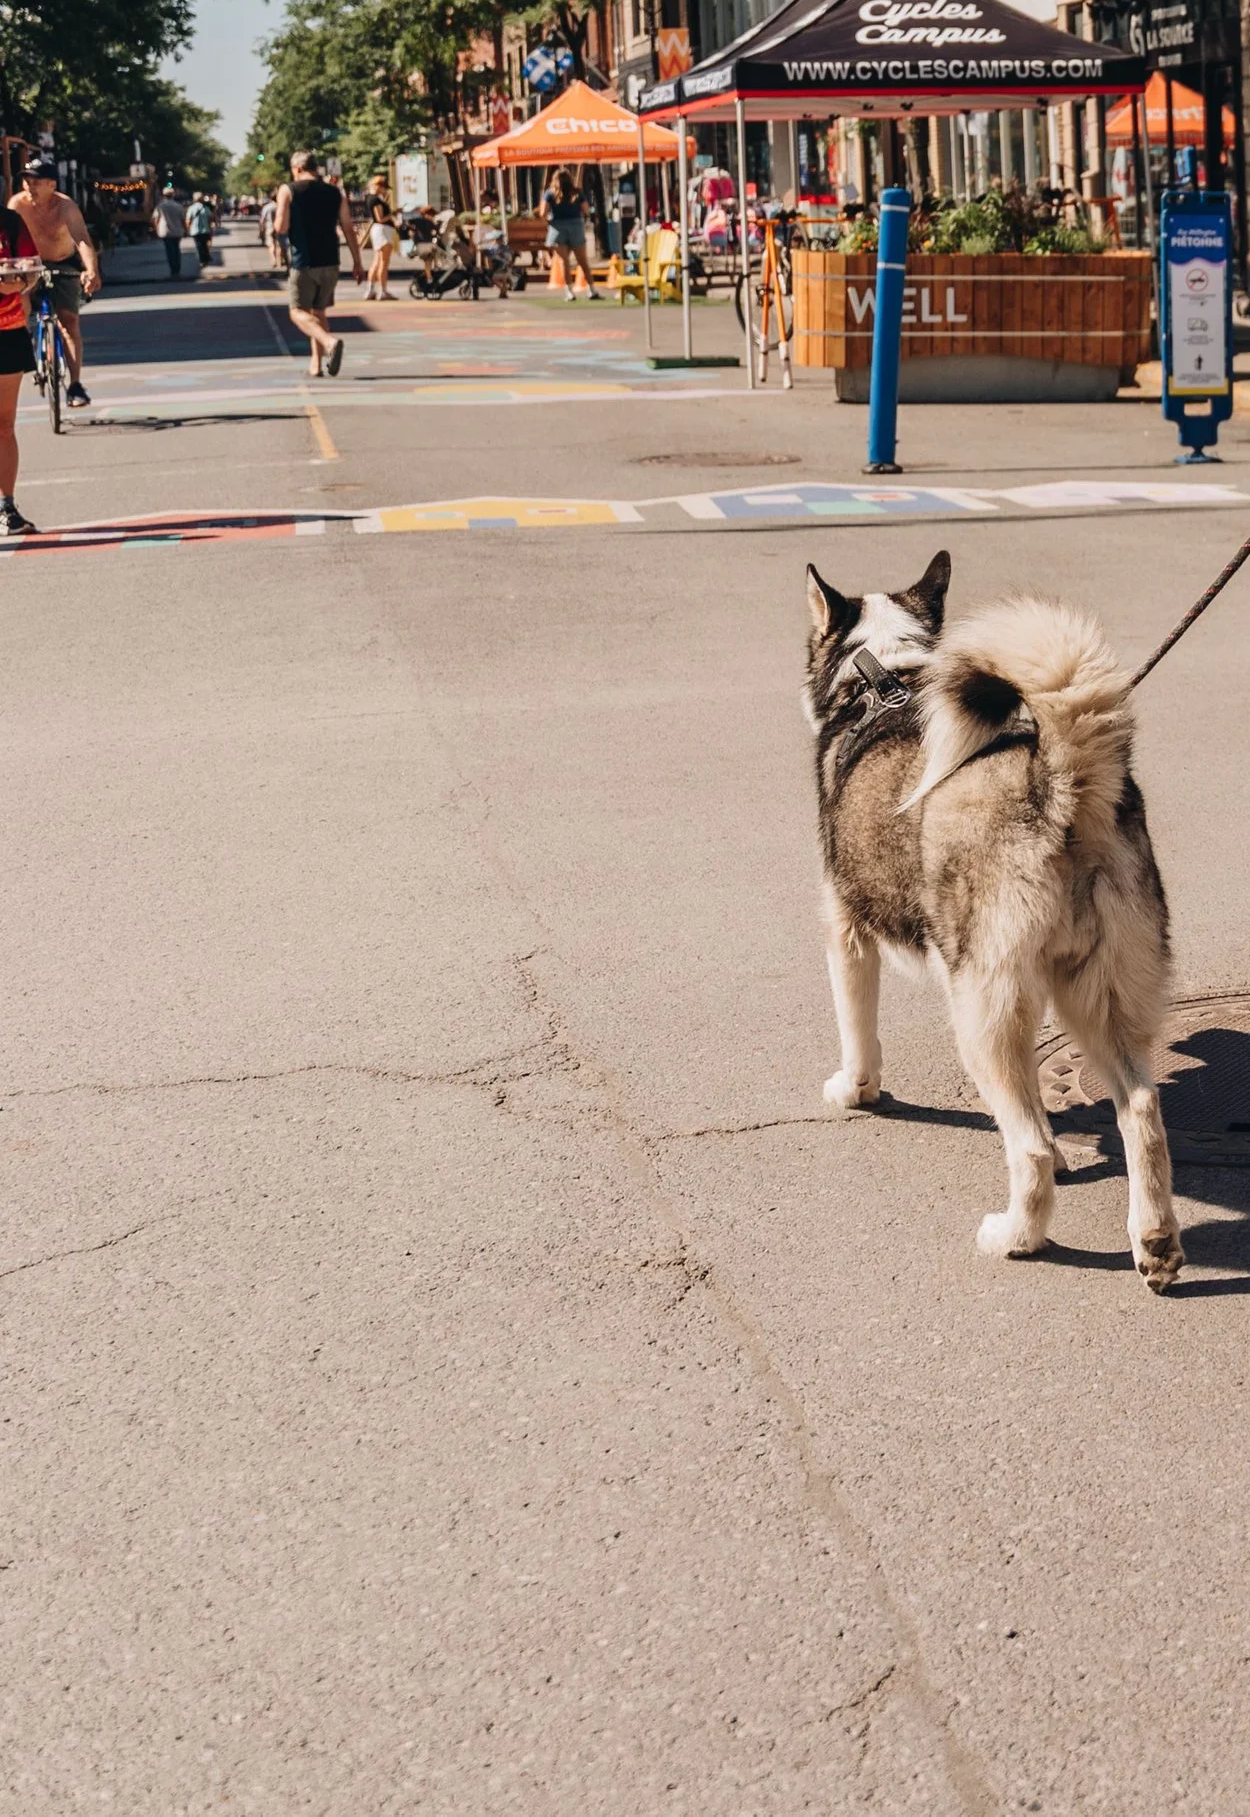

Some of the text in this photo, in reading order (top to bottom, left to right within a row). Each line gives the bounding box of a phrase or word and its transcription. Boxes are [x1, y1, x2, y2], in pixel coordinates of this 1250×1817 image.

[854, 24, 1007, 48] Campus
[783, 58, 1103, 81] WWW.CYCLESCAMPUS.COM
[545, 117, 638, 135] Chico
